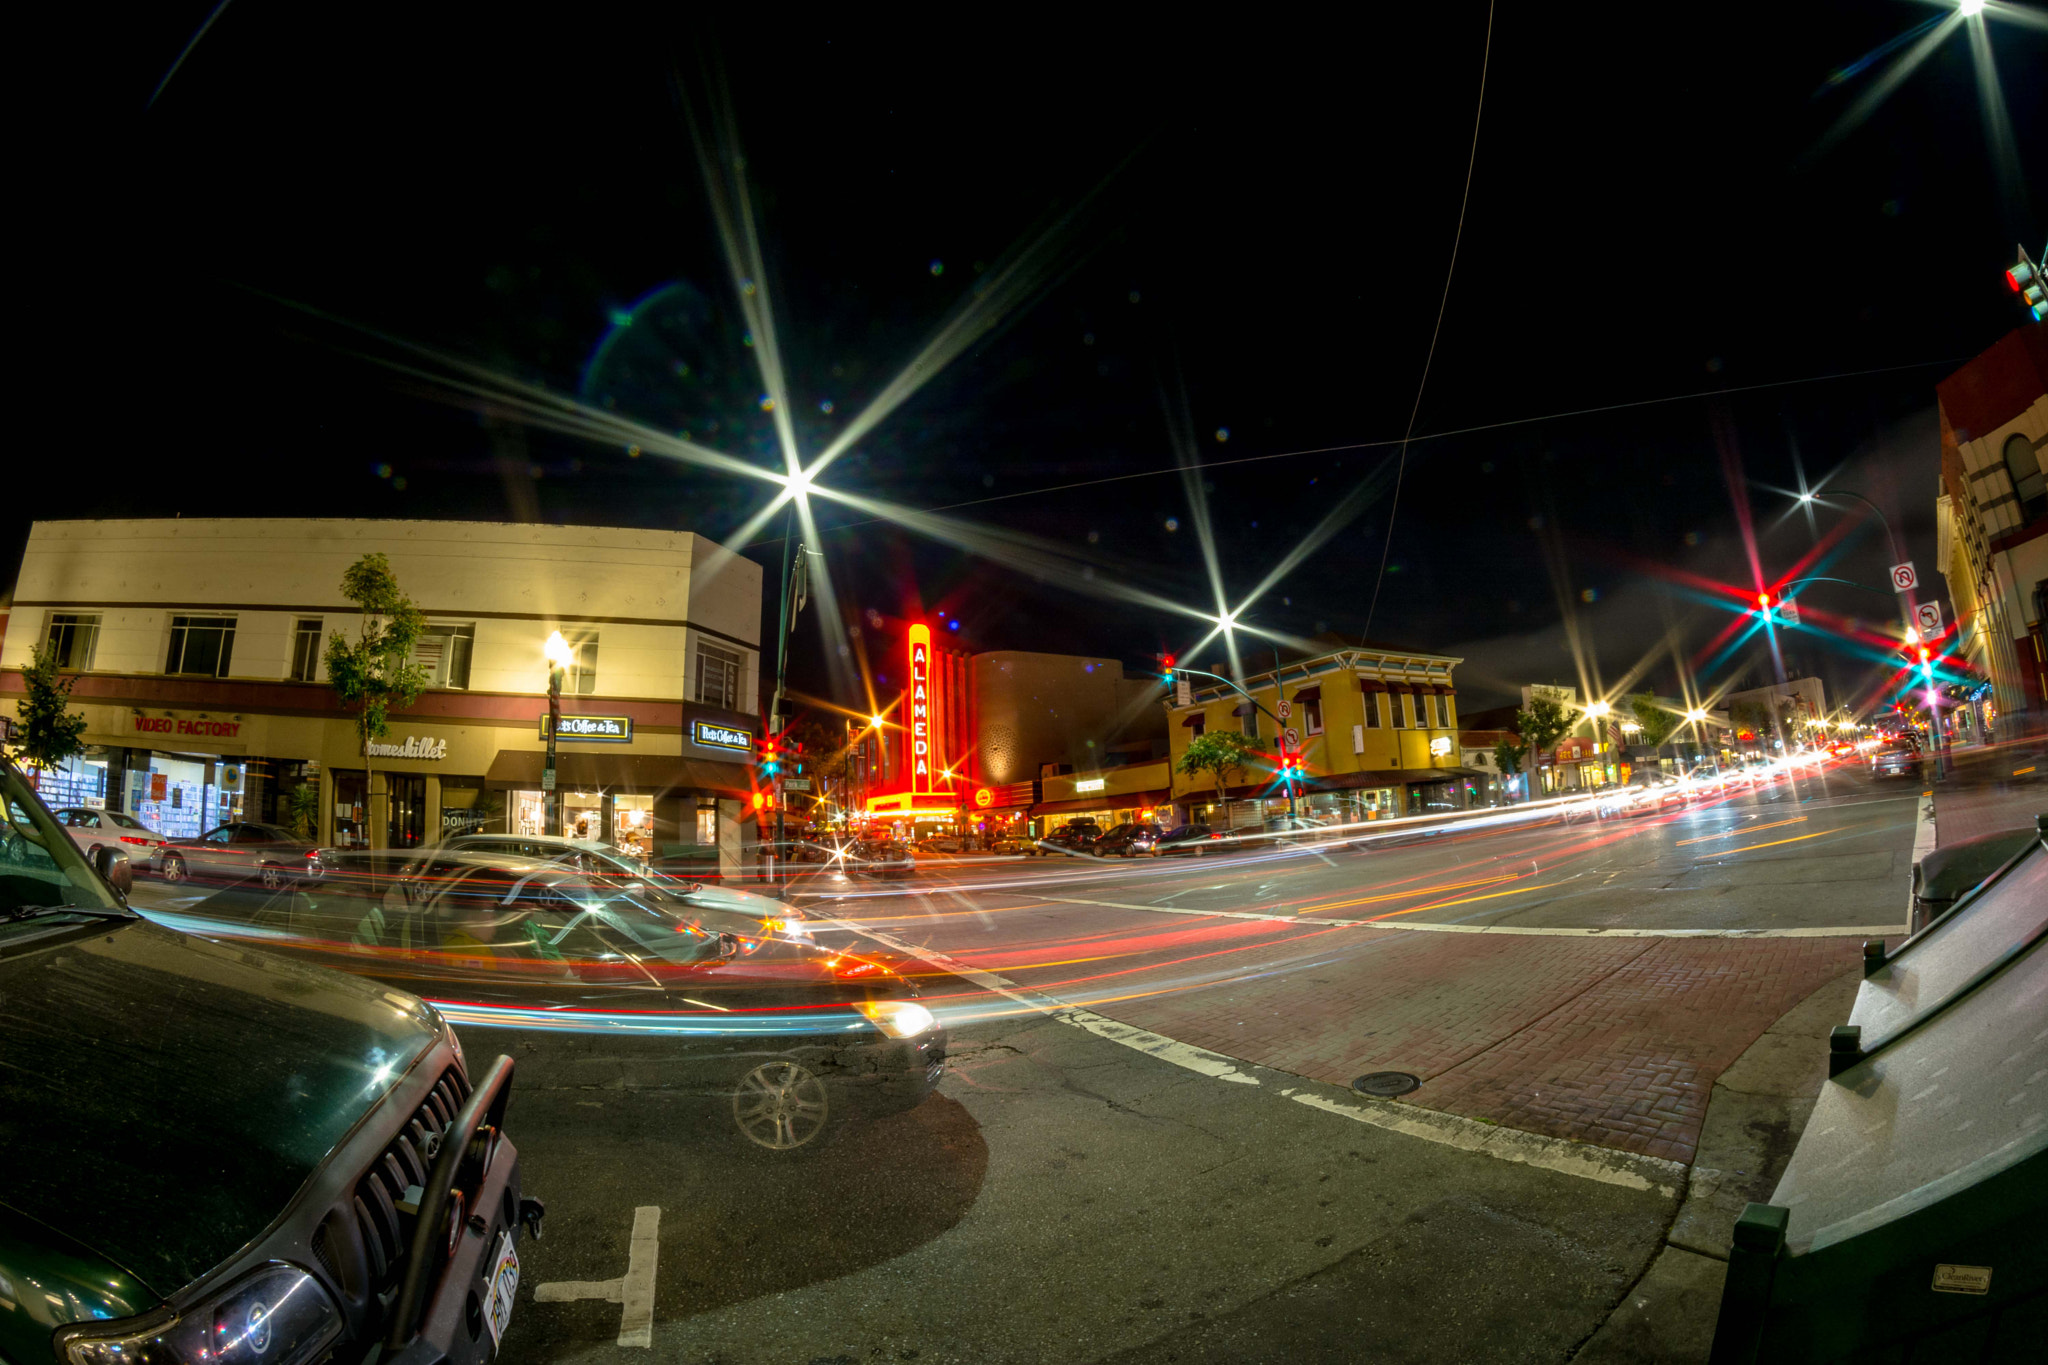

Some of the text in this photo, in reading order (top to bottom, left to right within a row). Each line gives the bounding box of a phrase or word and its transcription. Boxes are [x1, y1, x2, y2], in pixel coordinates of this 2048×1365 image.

[914, 648, 927, 775] ALAMEDA
[134, 717, 241, 738] VIDEO FACTORY
[571, 719, 597, 734] Coffee
[597, 723, 605, 732] &
[603, 720, 620, 734] Tea
